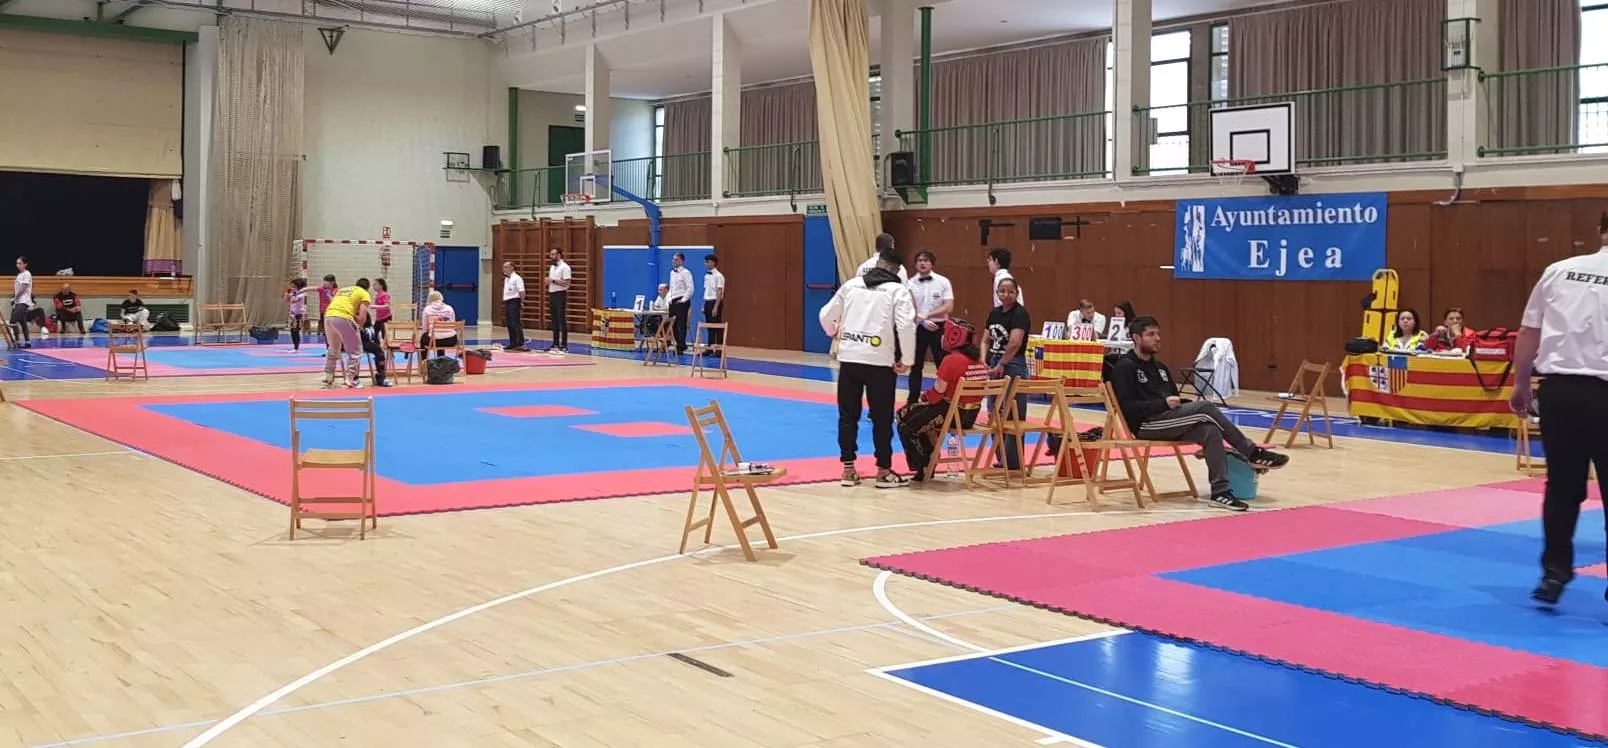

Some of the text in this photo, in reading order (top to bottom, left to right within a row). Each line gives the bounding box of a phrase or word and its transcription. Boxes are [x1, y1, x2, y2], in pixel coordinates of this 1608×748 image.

[1210, 202, 1377, 231] Ayuntamiento
[1247, 239, 1342, 276] Ejea
[1110, 325, 1120, 341] 2
